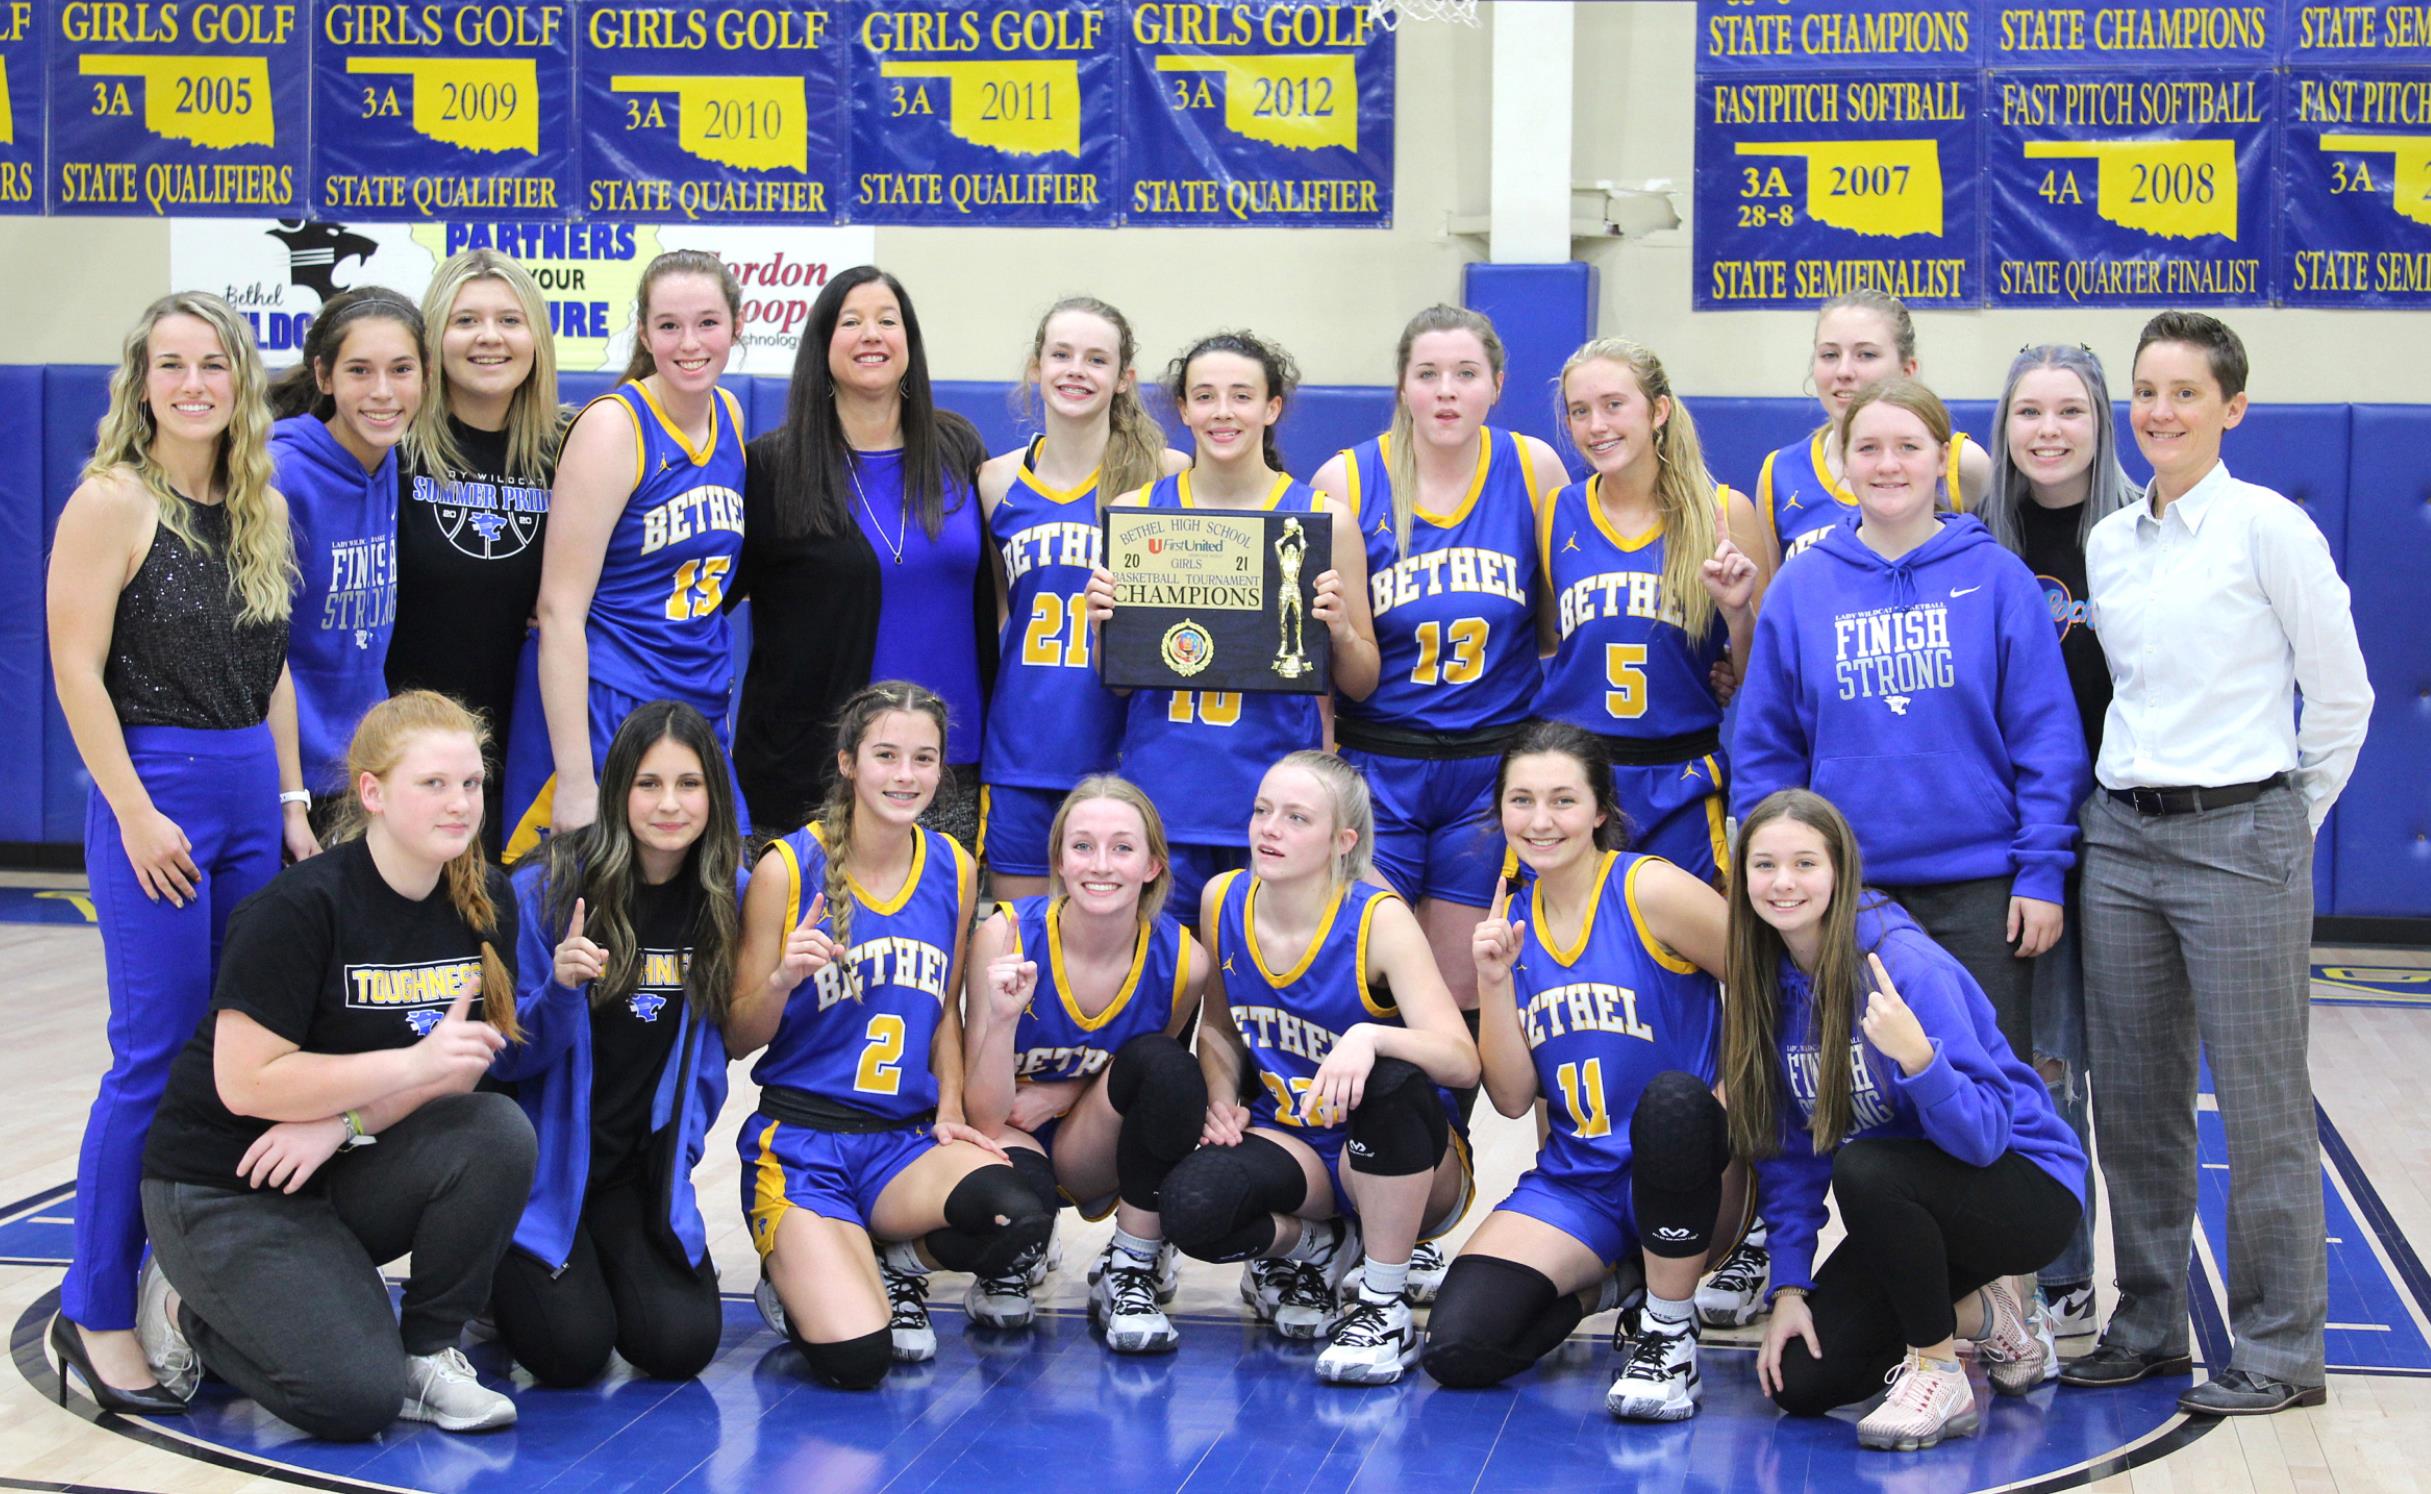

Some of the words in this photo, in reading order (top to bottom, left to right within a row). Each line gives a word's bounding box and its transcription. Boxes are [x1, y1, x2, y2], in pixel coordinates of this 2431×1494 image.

[62, 2, 178, 42] GIRLS
[192, 4, 295, 44] GOLF
[325, 5, 442, 45] GIRLS
[455, 6, 562, 46] GOLF
[589, 9, 707, 49] GIRLS
[716, 9, 828, 50] GOLF
[862, 11, 980, 51] GIRLS
[992, 10, 1104, 51] GOLF
[1133, 3, 1252, 45] GIRLS
[1262, 5, 1375, 47] GOLF
[1710, 15, 1792, 56] STATE
[1802, 12, 1968, 54] CHAMPIONS
[2001, 10, 2085, 50] STATE
[2095, 8, 2265, 49] CHAMPIONS
[2301, 7, 2376, 48] STATE
[92, 82, 133, 115] 3A
[177, 77, 251, 114] 2005
[364, 88, 400, 118] 3A
[441, 82, 517, 121] 2009
[893, 86, 931, 116] 3A
[980, 81, 1053, 121] 2011
[1176, 80, 1214, 109] 3A
[1254, 78, 1332, 116] 2012
[1715, 84, 1838, 123] FASTPITCH
[1848, 82, 1964, 121] SOFTBALL
[2004, 84, 2059, 125] FAST
[2066, 84, 2133, 125] PITCH
[2140, 81, 2260, 124] SOFTBALL
[2301, 81, 2357, 122] FAST
[2362, 81, 2431, 124] PITCH
[628, 100, 665, 129] 3A
[703, 100, 782, 139] 2010
[63, 163, 137, 202] STATE
[146, 163, 293, 214] QUALIFIERS
[326, 176, 405, 206] STATE
[413, 177, 558, 215] QUALIFIER
[861, 174, 942, 204] STATE
[950, 174, 1098, 213] QUALIFIER
[1741, 167, 1791, 197] 3A
[1832, 166, 1909, 195] 2007
[2039, 171, 2081, 203] 4A
[2132, 164, 2213, 202] 2008
[2331, 162, 2374, 193] 3A
[591, 181, 671, 210] STATE
[679, 181, 827, 219] QUALIFIER
[1135, 181, 1219, 212] STATE
[1227, 180, 1377, 220] QUALIFIER
[1739, 205, 1794, 227] 28-8
[446, 223, 637, 261] PARTNERS
[1713, 261, 1786, 299] STATE
[1794, 260, 1965, 298] SEMIFINALIST
[2002, 261, 2059, 293] STATE
[2066, 261, 2161, 299] QUARTER
[2168, 260, 2258, 293] FINALIST
[2294, 251, 2368, 290] STATE
[225, 281, 284, 309] Bethel
[413, 475, 498, 509] SUMMER
[443, 510, 456, 519] 20
[519, 516, 532, 525] 20
[1120, 521, 1165, 546] BETHEL
[1171, 519, 1200, 532] HIGH
[1206, 521, 1252, 549] SCHOOL
[1113, 572, 1179, 585] BASKETBALL
[1186, 574, 1260, 587] TOURNAMENT
[1124, 553, 1140, 568] 20
[1171, 558, 1202, 569] GIRLS
[1236, 556, 1248, 571] 21
[665, 555, 731, 621] 15
[1113, 584, 1260, 607] CHAMPIONS
[1371, 547, 1526, 618] BETHEL
[1021, 592, 1089, 668] 21
[1835, 612, 1857, 622] LADY
[1857, 606, 1893, 618] WILDCAT
[1410, 617, 1490, 686] 13
[1835, 608, 1950, 661] FINISH
[1606, 643, 1648, 719] 5
[1836, 649, 1955, 701] STRONG
[1518, 983, 1655, 1050] ETHEL
[853, 1013, 906, 1096] 2
[1557, 1057, 1612, 1138] 11
